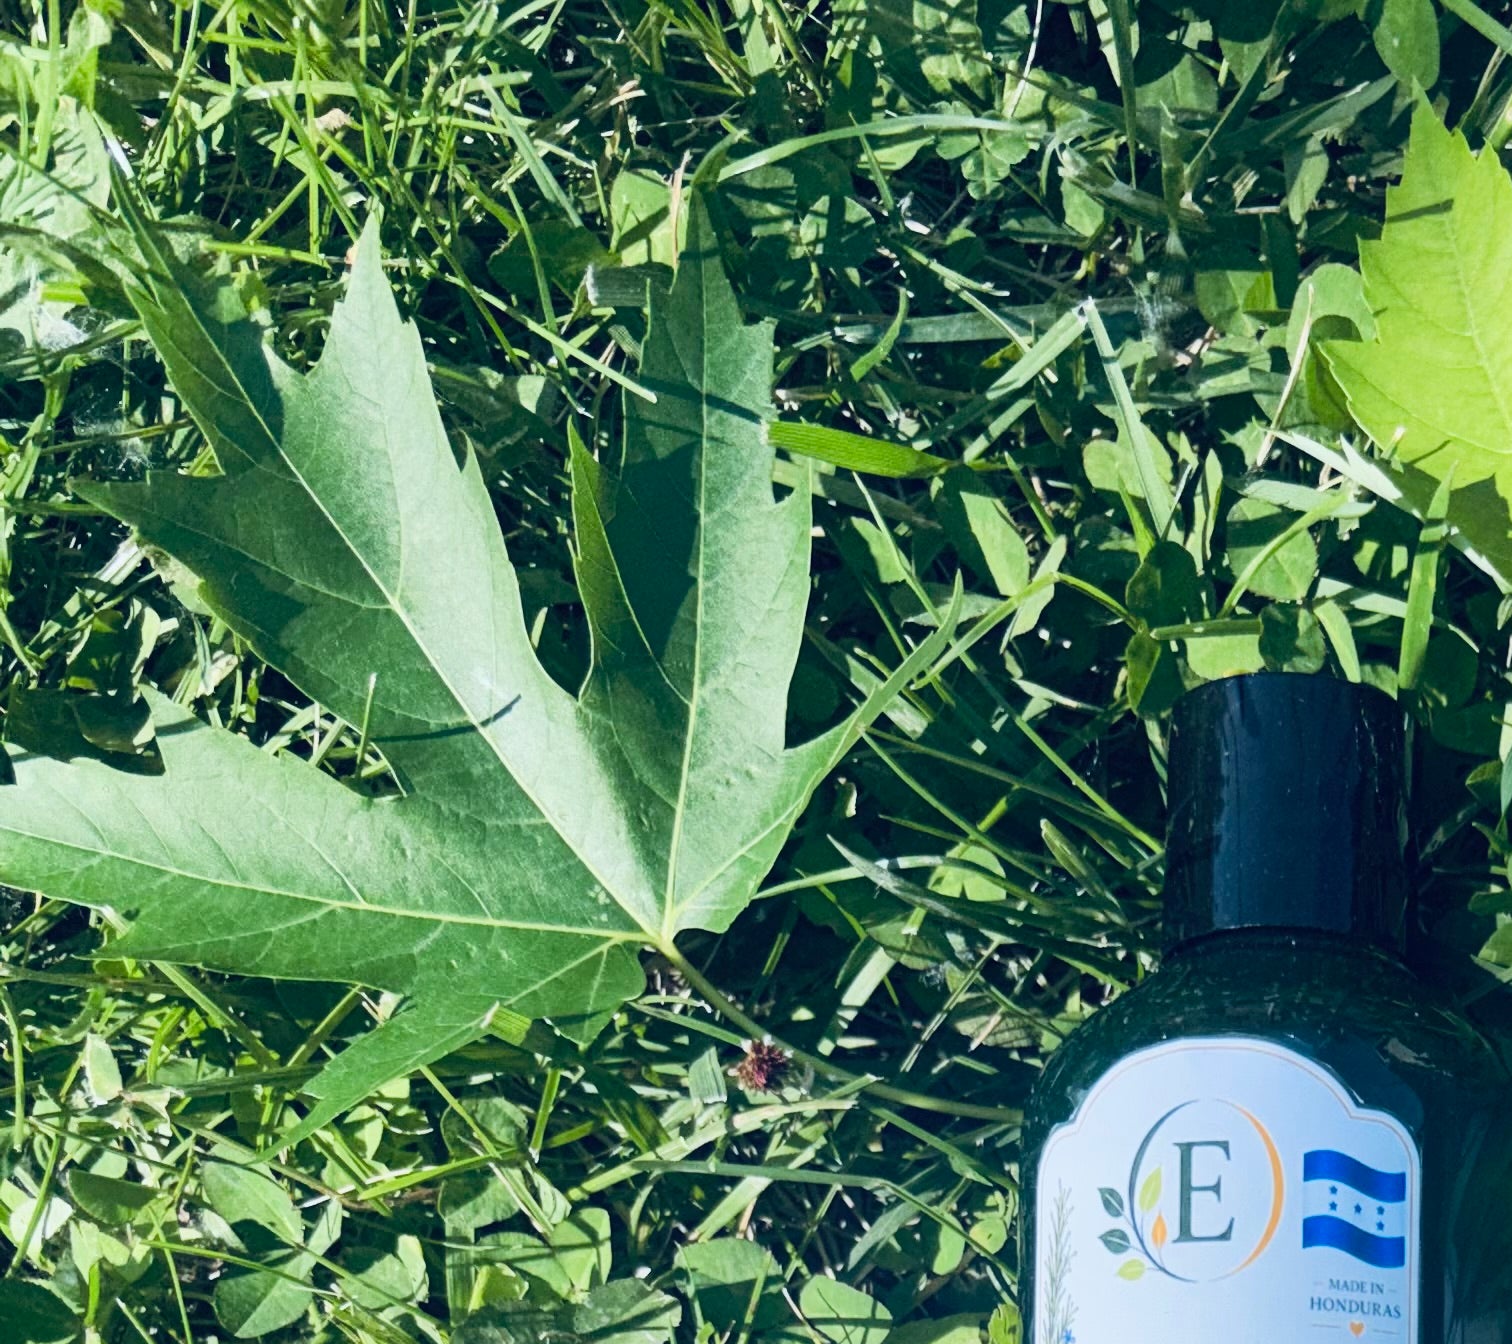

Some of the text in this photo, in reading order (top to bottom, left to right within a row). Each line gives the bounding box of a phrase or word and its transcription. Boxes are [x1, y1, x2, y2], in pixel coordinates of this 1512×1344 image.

[1328, 1277, 1385, 1295] MADE IN
[1310, 1297, 1401, 1319] HONDURAS
